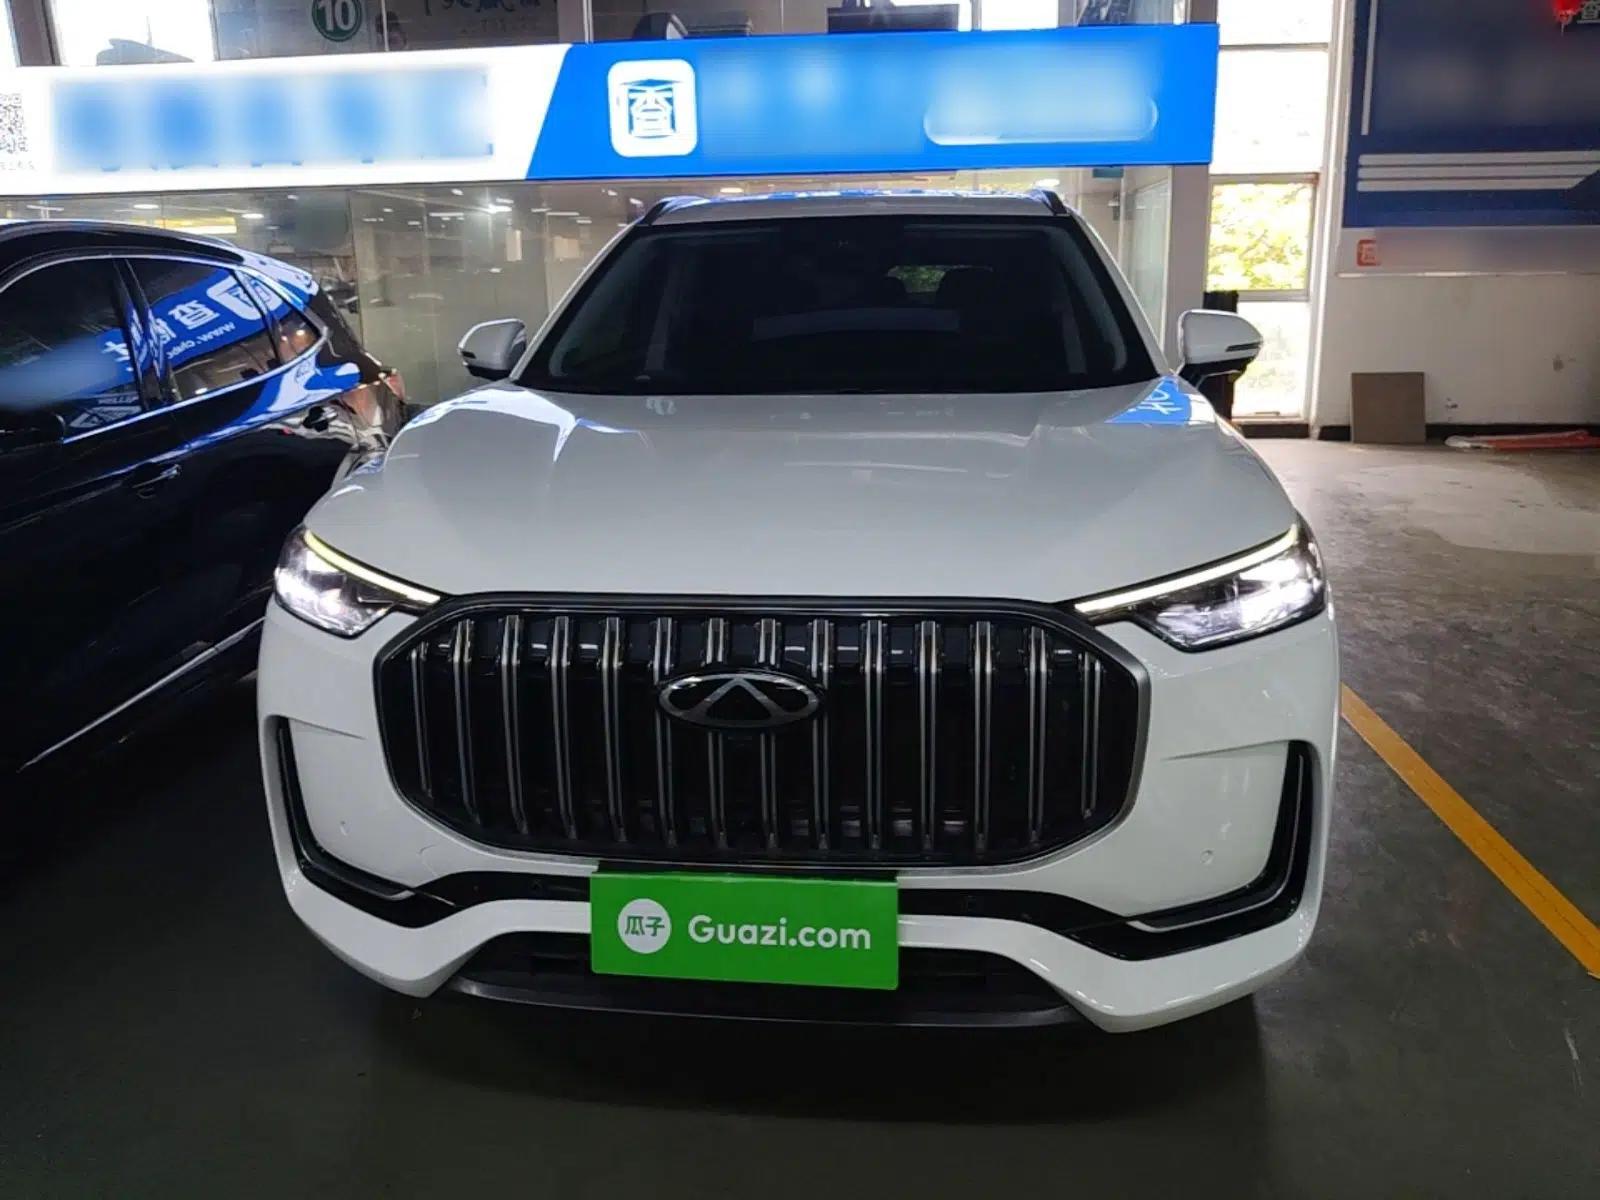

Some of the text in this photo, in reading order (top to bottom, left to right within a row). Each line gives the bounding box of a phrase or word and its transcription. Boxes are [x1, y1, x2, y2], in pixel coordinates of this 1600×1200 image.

[317, 0, 356, 31] 10
[625, 915, 665, 937] 瓜子
[688, 914, 871, 950] Guazi.com
